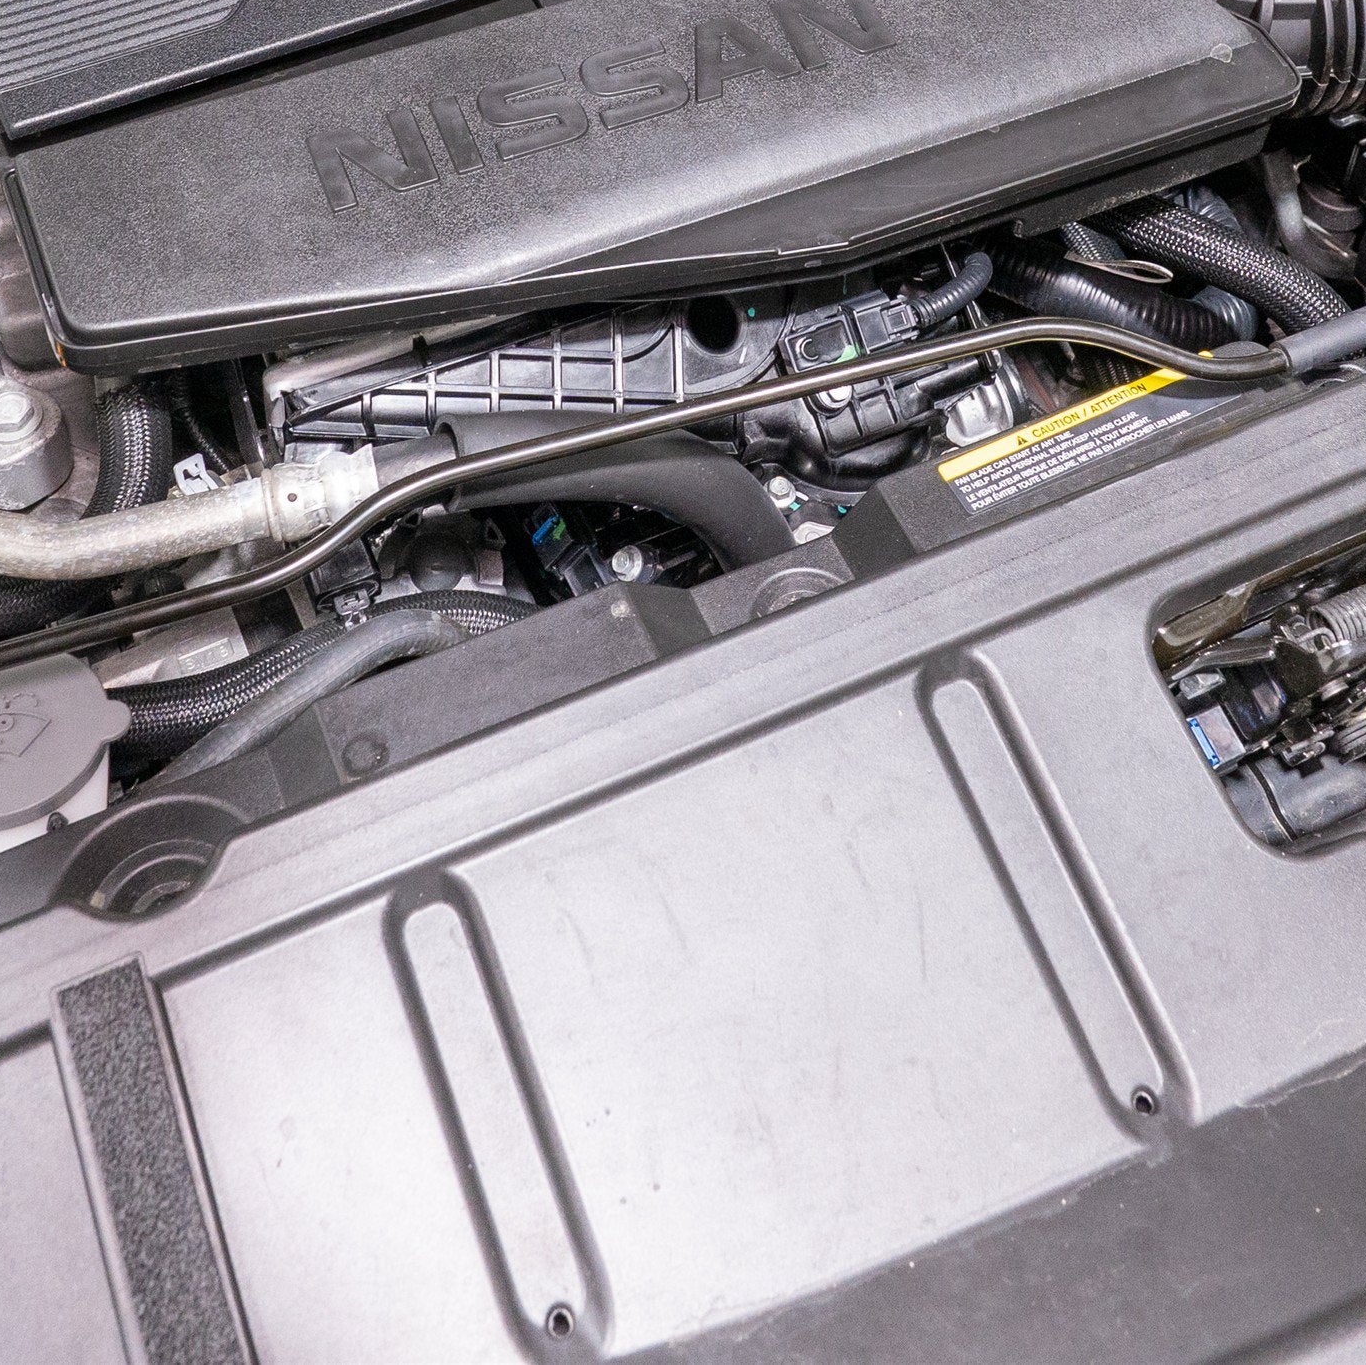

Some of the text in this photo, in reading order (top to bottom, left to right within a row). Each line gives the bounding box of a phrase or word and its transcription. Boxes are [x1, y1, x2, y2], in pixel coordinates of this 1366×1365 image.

[960, 483, 972, 494] TO
[972, 475, 990, 489] HELP
[991, 467, 1013, 481] AVOID
[1013, 451, 1050, 471] PERSONAL
[1090, 419, 1115, 437] HANDS
[1114, 410, 1139, 426] CLEAR.
[1031, 412, 1081, 438] CAUTION
[1090, 383, 1147, 413] ATTENTION
[954, 474, 970, 486] FAN
[970, 464, 993, 482] BLADE
[993, 457, 1011, 469] CAN
[1010, 448, 1032, 462] START
[1032, 443, 1042, 453] AT
[1042, 438, 1057, 449] ANY
[966, 493, 977, 503] LE
[977, 473, 1024, 498] VENTILATEUR
[1022, 463, 1047, 479] RISQUE
[1047, 457, 1058, 467] DE
[1058, 441, 1098, 462] DÉMARRER
[1102, 430, 1120, 443] TOUT
[1119, 416, 1152, 437] MOMENT.
[971, 496, 994, 511] POUR
[994, 485, 1020, 502] ÉVITER
[1018, 475, 1041, 490] TOUTE
[1078, 452, 1090, 463] NE
[1089, 446, 1104, 458] PAS
[1103, 441, 1115, 452] EN
[1113, 423, 1156, 448] APPROCHER
[1155, 417, 1168, 429] LES
[1166, 409, 1192, 424] MAINS.
